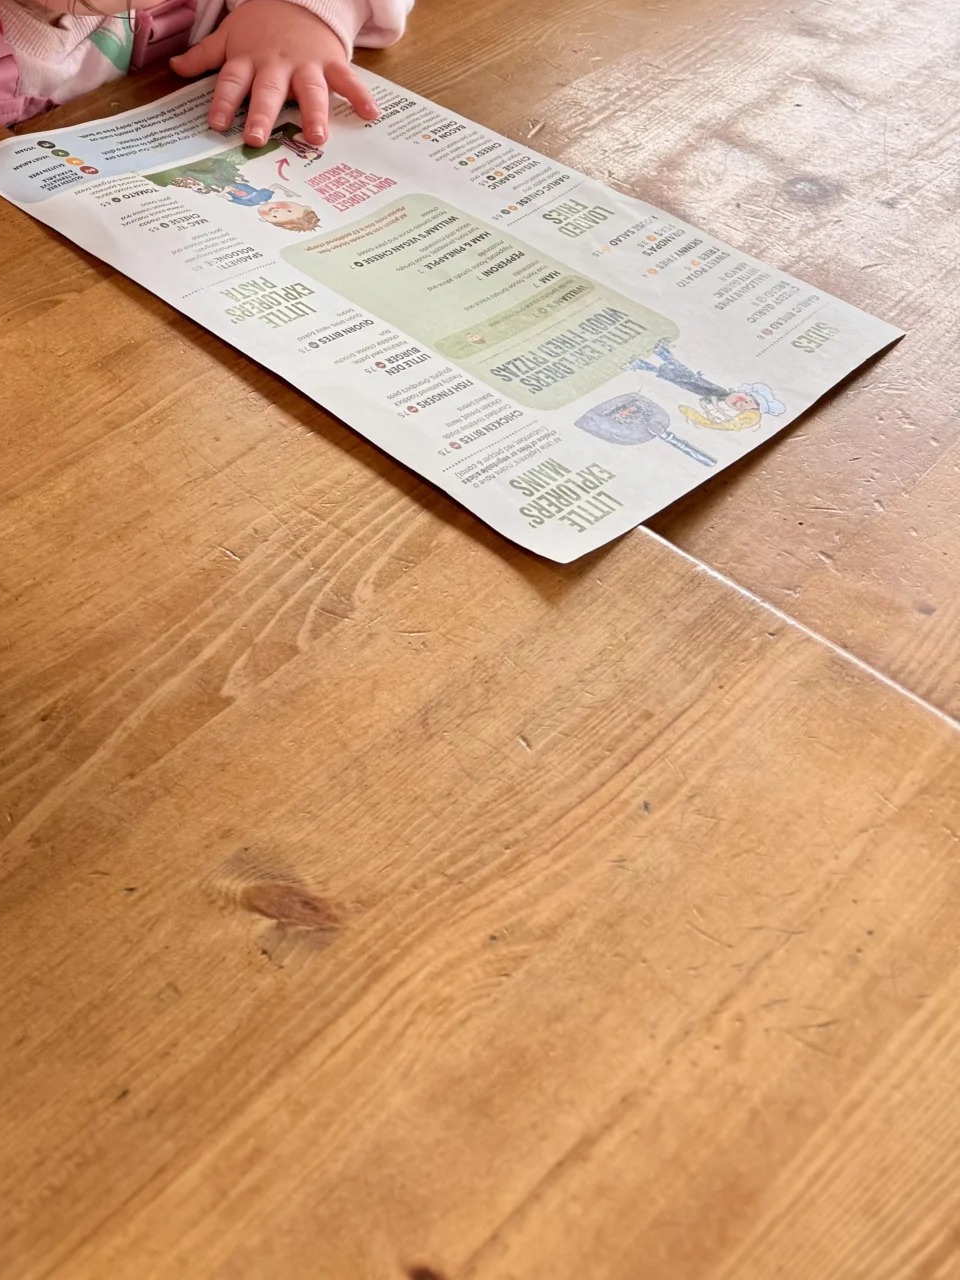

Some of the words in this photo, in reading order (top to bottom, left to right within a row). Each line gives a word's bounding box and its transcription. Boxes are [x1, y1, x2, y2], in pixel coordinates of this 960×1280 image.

[429, 120, 458, 135] CHEESE
[438, 124, 467, 139] BACON
[473, 142, 502, 158] CHEESY
[502, 156, 531, 171] CHEESE
[512, 160, 541, 175] VEGAN
[304, 163, 352, 187] PARLOUR!
[344, 168, 366, 180] ICE
[486, 173, 516, 190] GARLIC
[542, 174, 570, 191] GARLIC
[121, 187, 158, 199] TOMATO
[314, 176, 350, 194] CREAM
[340, 179, 370, 194] VISIT
[365, 177, 397, 195] DON'T
[321, 190, 346, 203] OUR
[331, 190, 371, 212] FORGET
[515, 189, 545, 206] CHEESE
[168, 213, 200, 225] CHEESE
[541, 198, 588, 224] FRIES
[416, 215, 459, 237] WILLIAM'S
[556, 205, 615, 238] LOADED
[389, 236, 419, 251] VEGAN
[469, 231, 492, 244] HAM
[608, 229, 636, 246] SALAD
[361, 248, 392, 264] CHEESE
[673, 238, 703, 257] SKINNY
[423, 245, 466, 270] PINEAPPLE
[481, 250, 525, 277] PEPPERONI
[538, 270, 561, 284] HAM
[220, 276, 277, 302] PASTA
[257, 301, 316, 328] LITTLE
[769, 311, 796, 330] BREAD
[340, 318, 374, 334] QUORN
[590, 318, 648, 351] LITTLE
[317, 331, 344, 344] BITES
[789, 321, 839, 354] SIDES
[384, 346, 421, 364] BURGER
[402, 353, 431, 368] LITTLE
[384, 364, 406, 376] DEN
[489, 350, 548, 382] PIZZAS
[450, 379, 474, 392] FISH
[416, 388, 455, 408] FINGERS
[481, 409, 523, 432] CHICKEN
[458, 429, 486, 444] BITES
[507, 458, 571, 497] MAINS
[516, 463, 614, 528] EXPLORERS'
[558, 490, 623, 533] LITTLE
